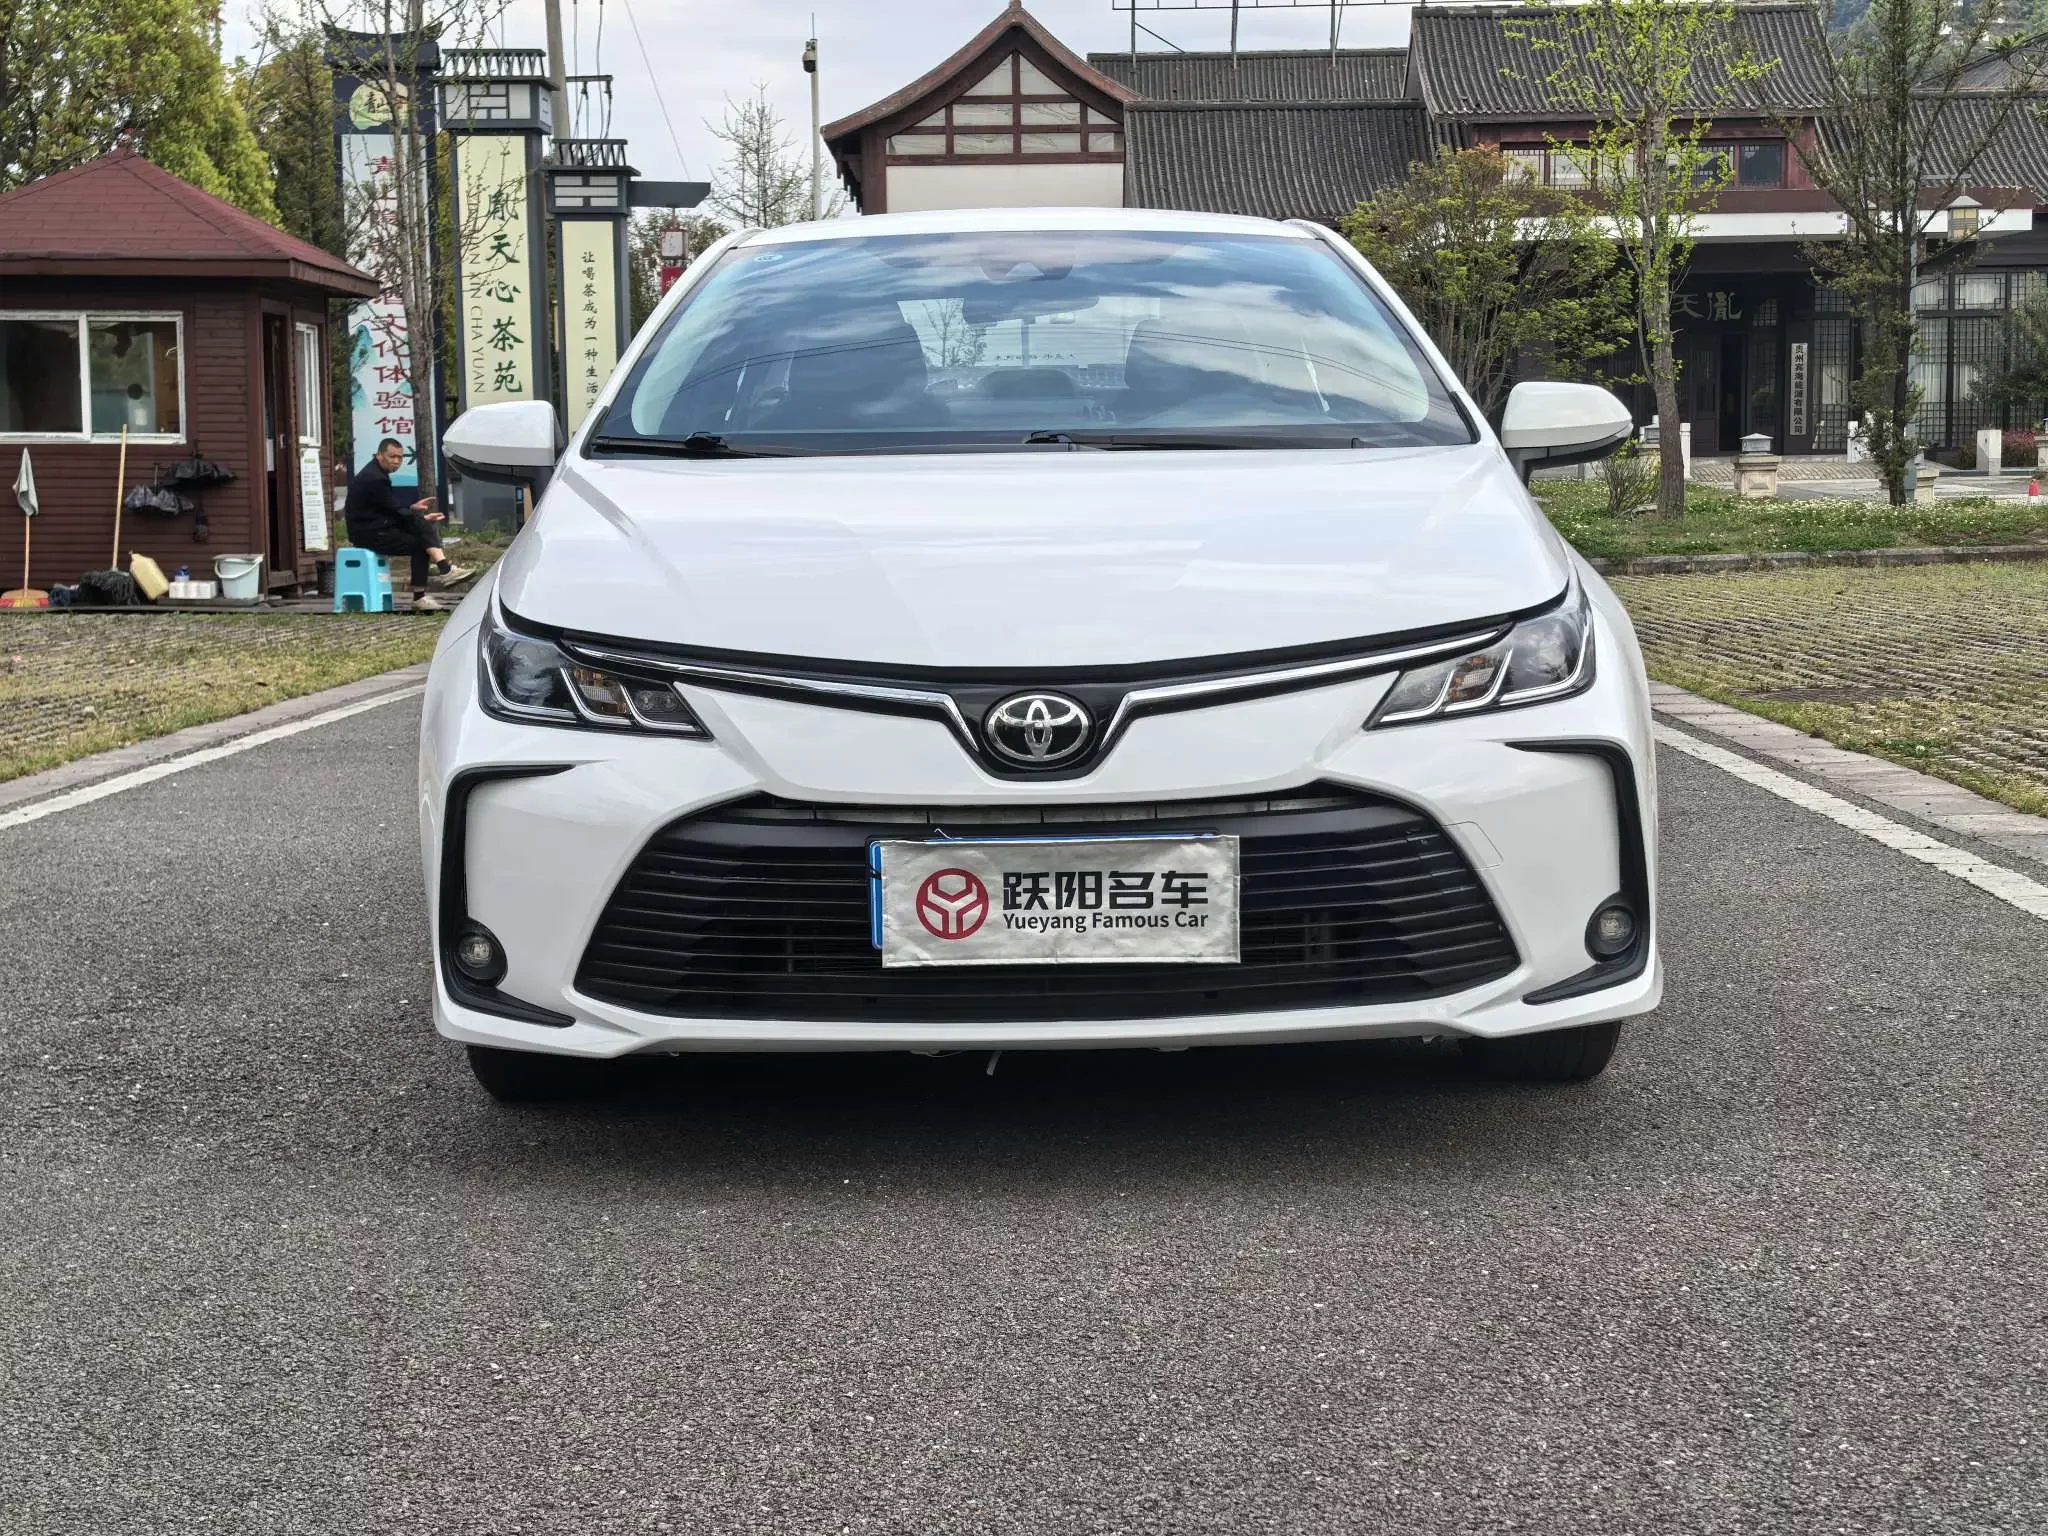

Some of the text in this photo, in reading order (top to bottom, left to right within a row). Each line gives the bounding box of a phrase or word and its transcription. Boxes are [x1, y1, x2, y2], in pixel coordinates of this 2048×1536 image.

[485, 192, 524, 393] 胤天心茶苑
[471, 306, 484, 340] CHA
[472, 347, 486, 393] YUAN
[1002, 870, 1209, 910] 跃阳名车
[1003, 911, 1208, 933] Yueyang Famous Car
